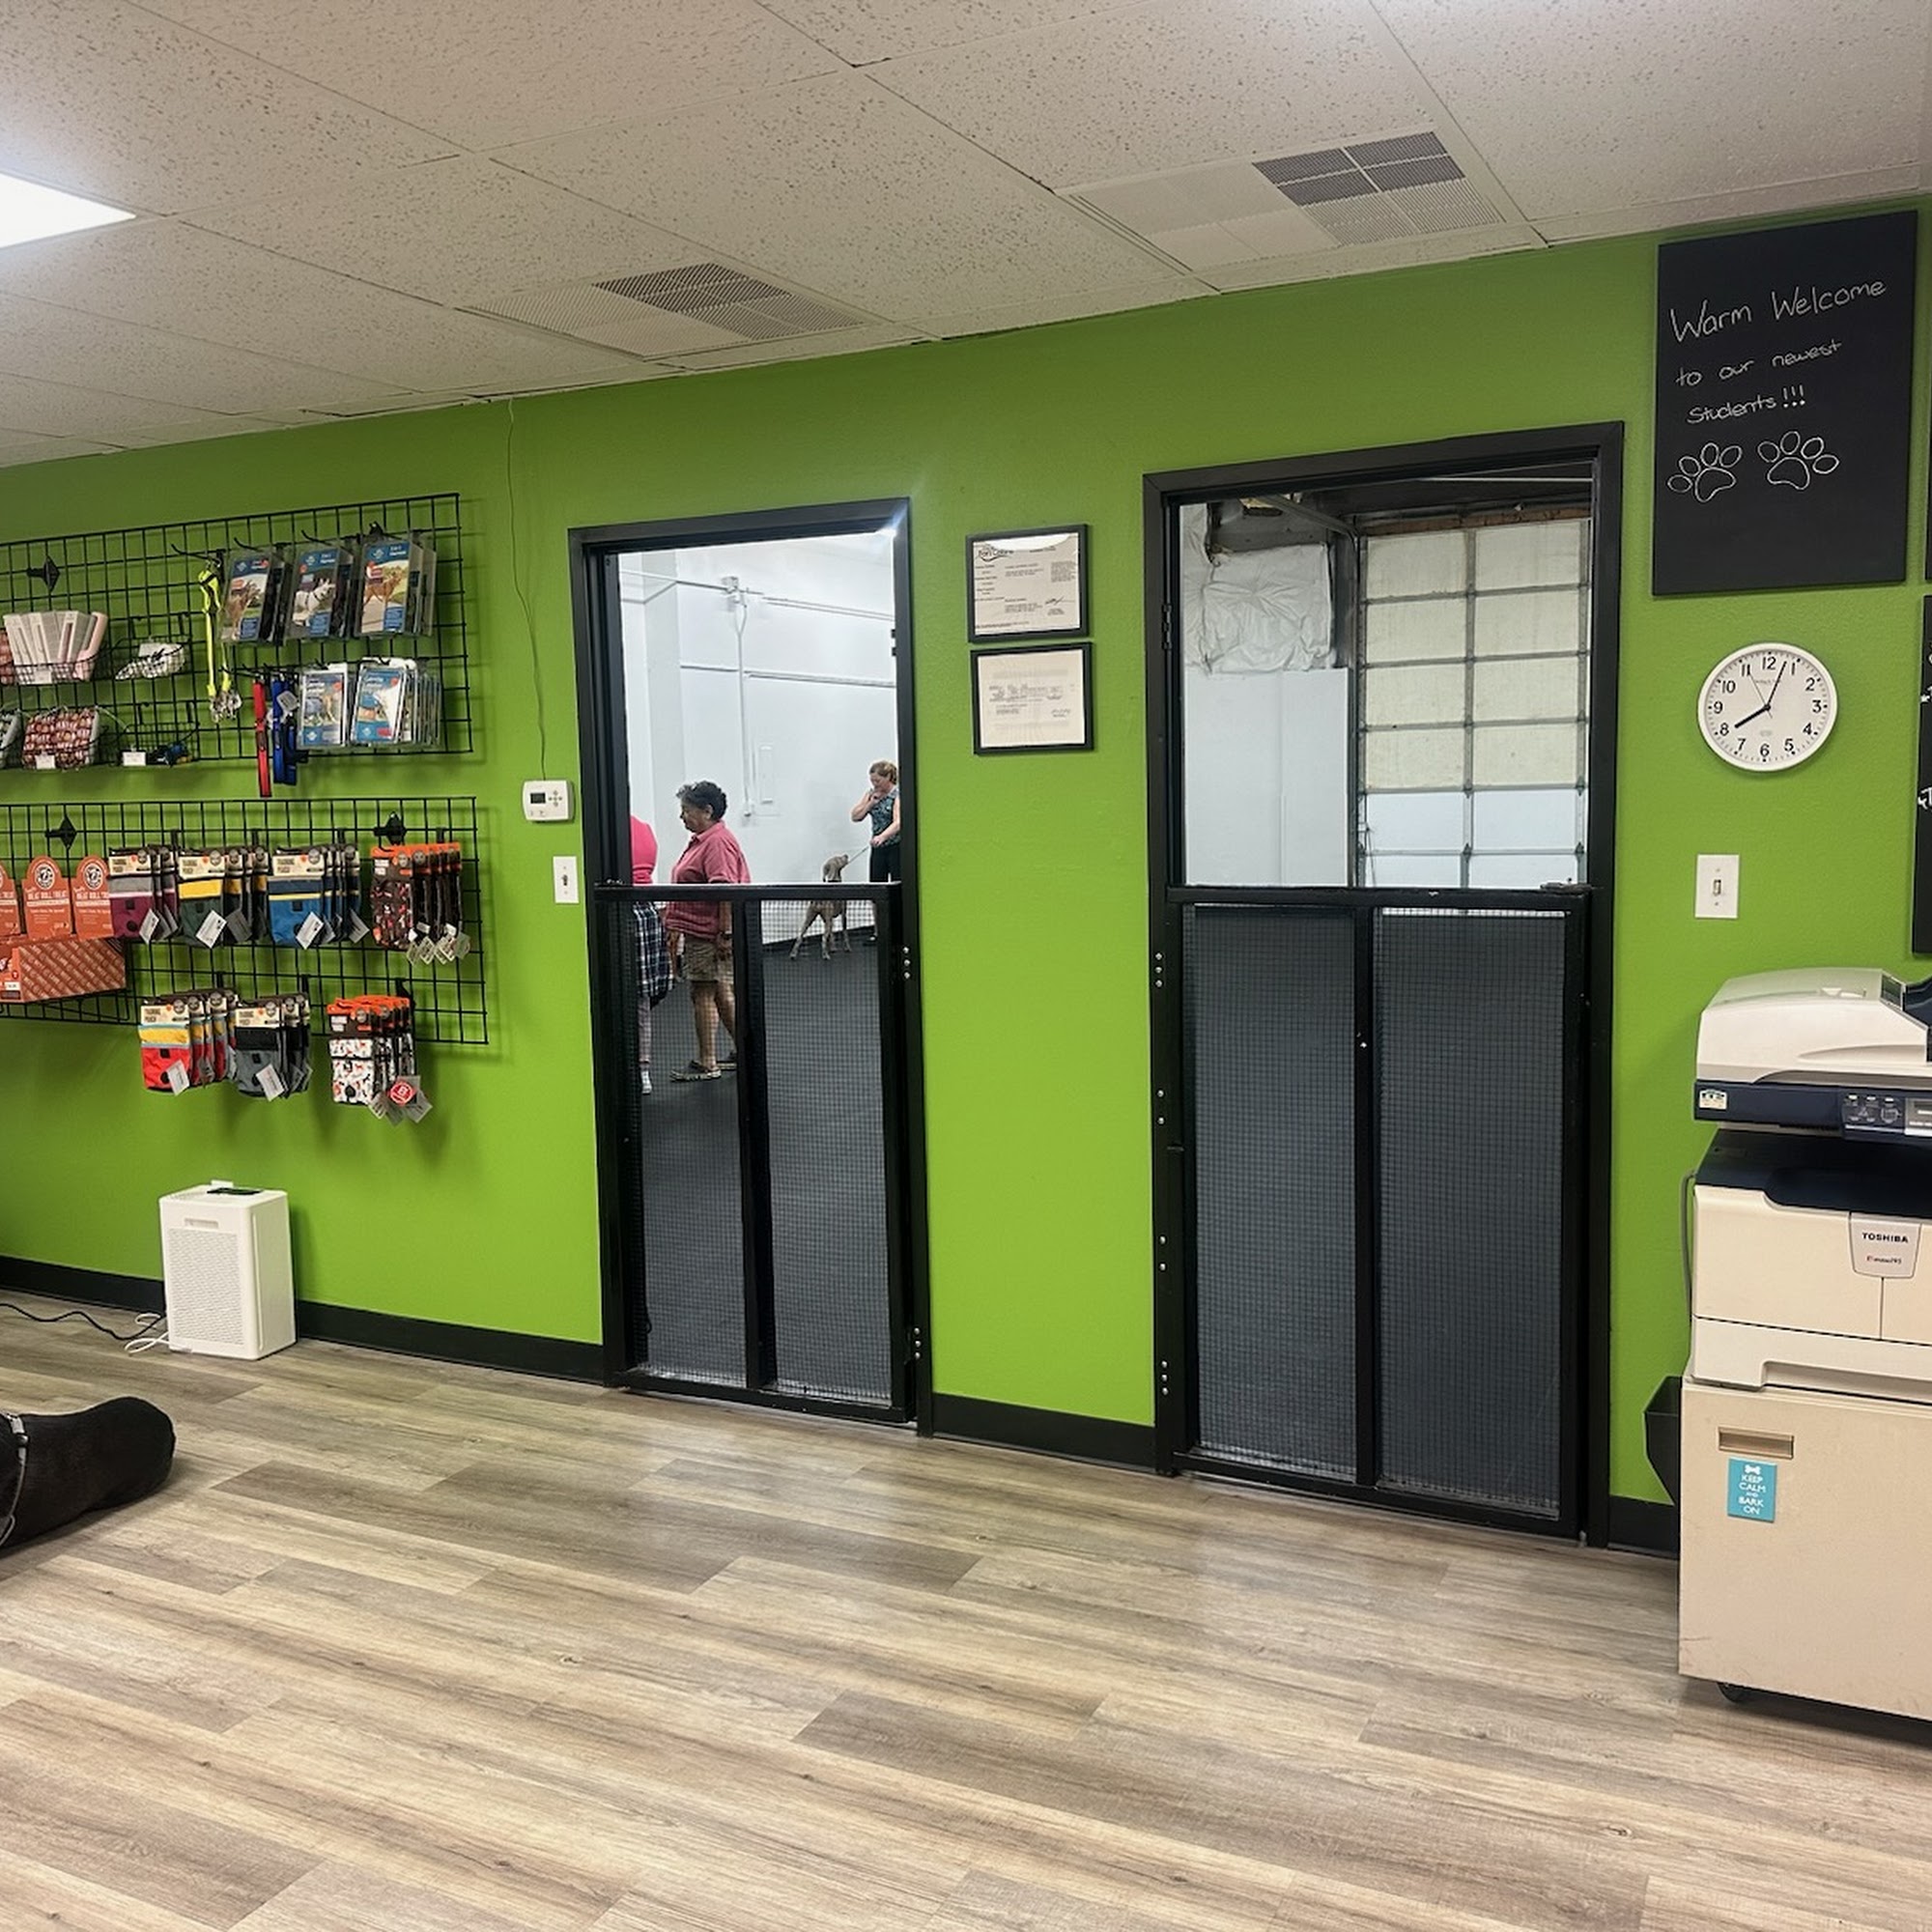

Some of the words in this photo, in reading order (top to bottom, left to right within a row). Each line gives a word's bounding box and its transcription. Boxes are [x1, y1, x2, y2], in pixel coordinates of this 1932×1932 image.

[1669, 299, 1752, 342] Warm
[1771, 279, 1888, 321] Welcome
[1675, 367, 1702, 386] to
[1719, 358, 1755, 380] our
[1772, 339, 1843, 368] newest
[1762, 656, 1776, 670] 12
[1791, 662, 1796, 676] 1
[1741, 664, 1750, 677] 11
[1721, 680, 1736, 694] 10
[1805, 677, 1815, 692] 2
[1714, 700, 1723, 714] 9
[1812, 699, 1822, 714] 3
[1719, 723, 1729, 736] 8
[1803, 722, 1812, 735] 4
[1738, 738, 1747, 752] 7
[1760, 743, 1770, 757] 6
[1784, 738, 1794, 752] 5
[1861, 1232, 1909, 1243] TOSHIBA
[1739, 1483, 1766, 1492] CALM
[1739, 1496, 1764, 1507] BARK
[1743, 1505, 1760, 1515] ON
